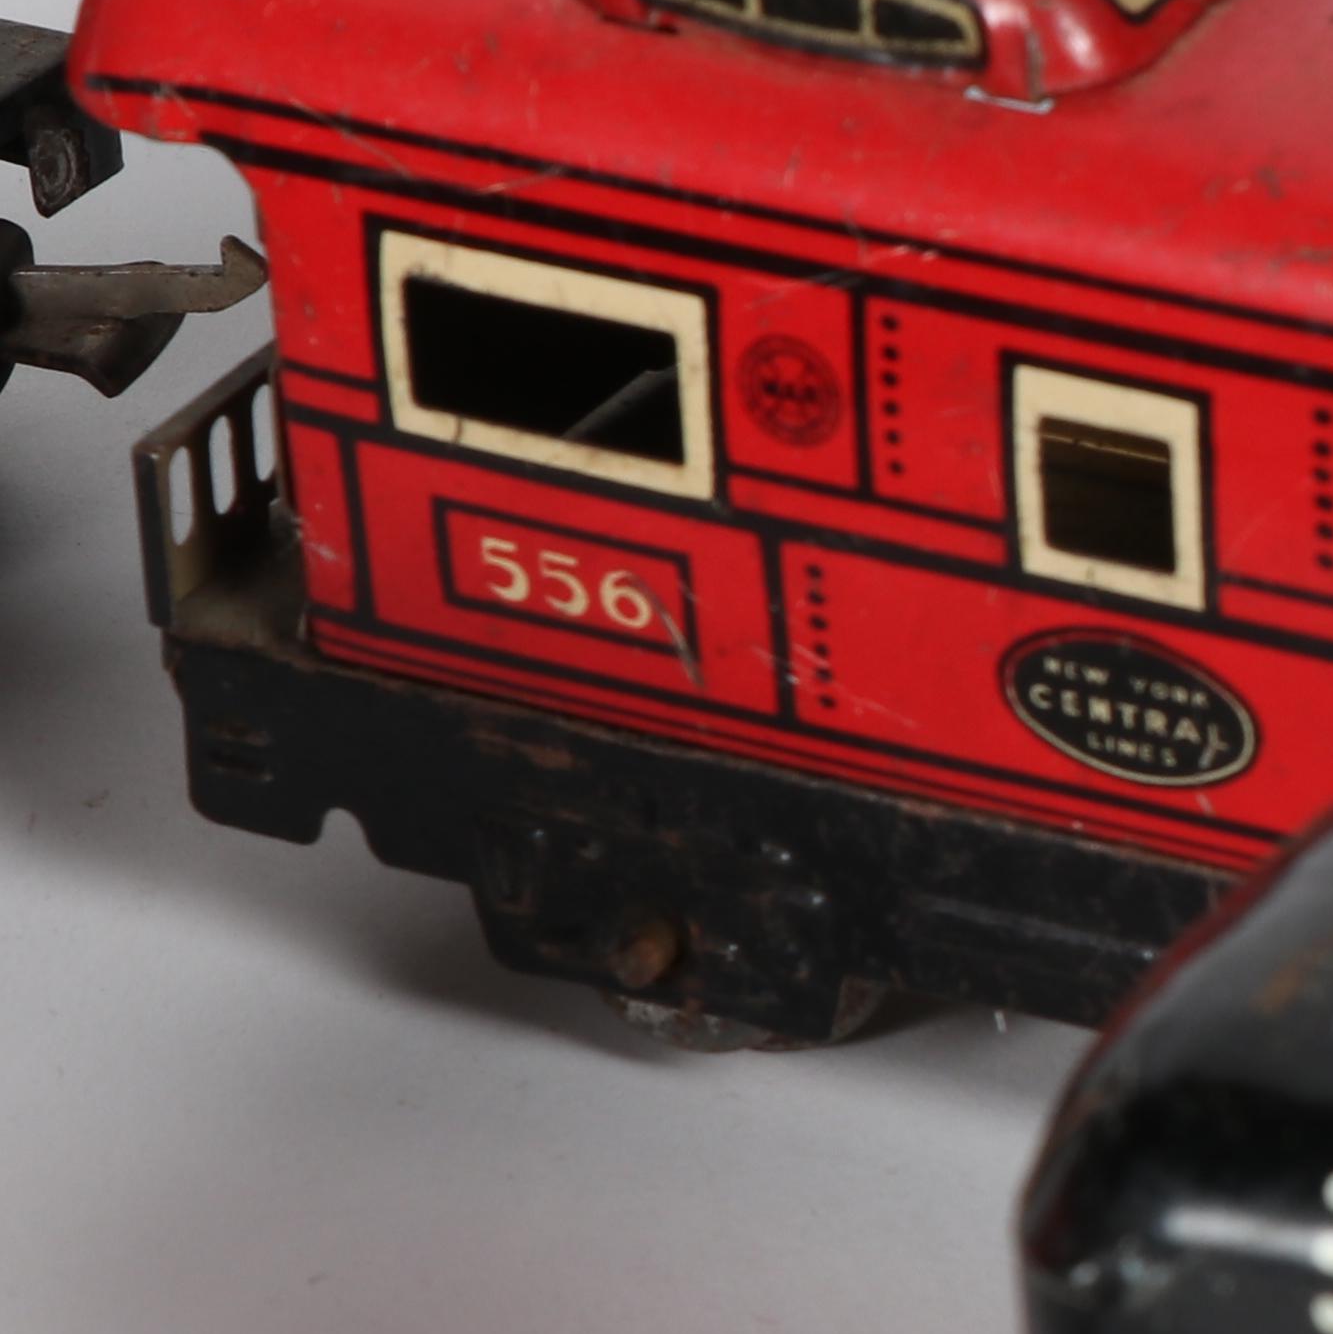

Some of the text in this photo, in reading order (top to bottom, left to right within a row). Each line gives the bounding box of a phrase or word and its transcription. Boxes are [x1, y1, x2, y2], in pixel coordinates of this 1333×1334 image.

[479, 536, 653, 628] 556
[1042, 655, 1209, 708] NEW YORK
[1028, 682, 1228, 761] CENTRAL
[1087, 729, 1178, 768] LINES
